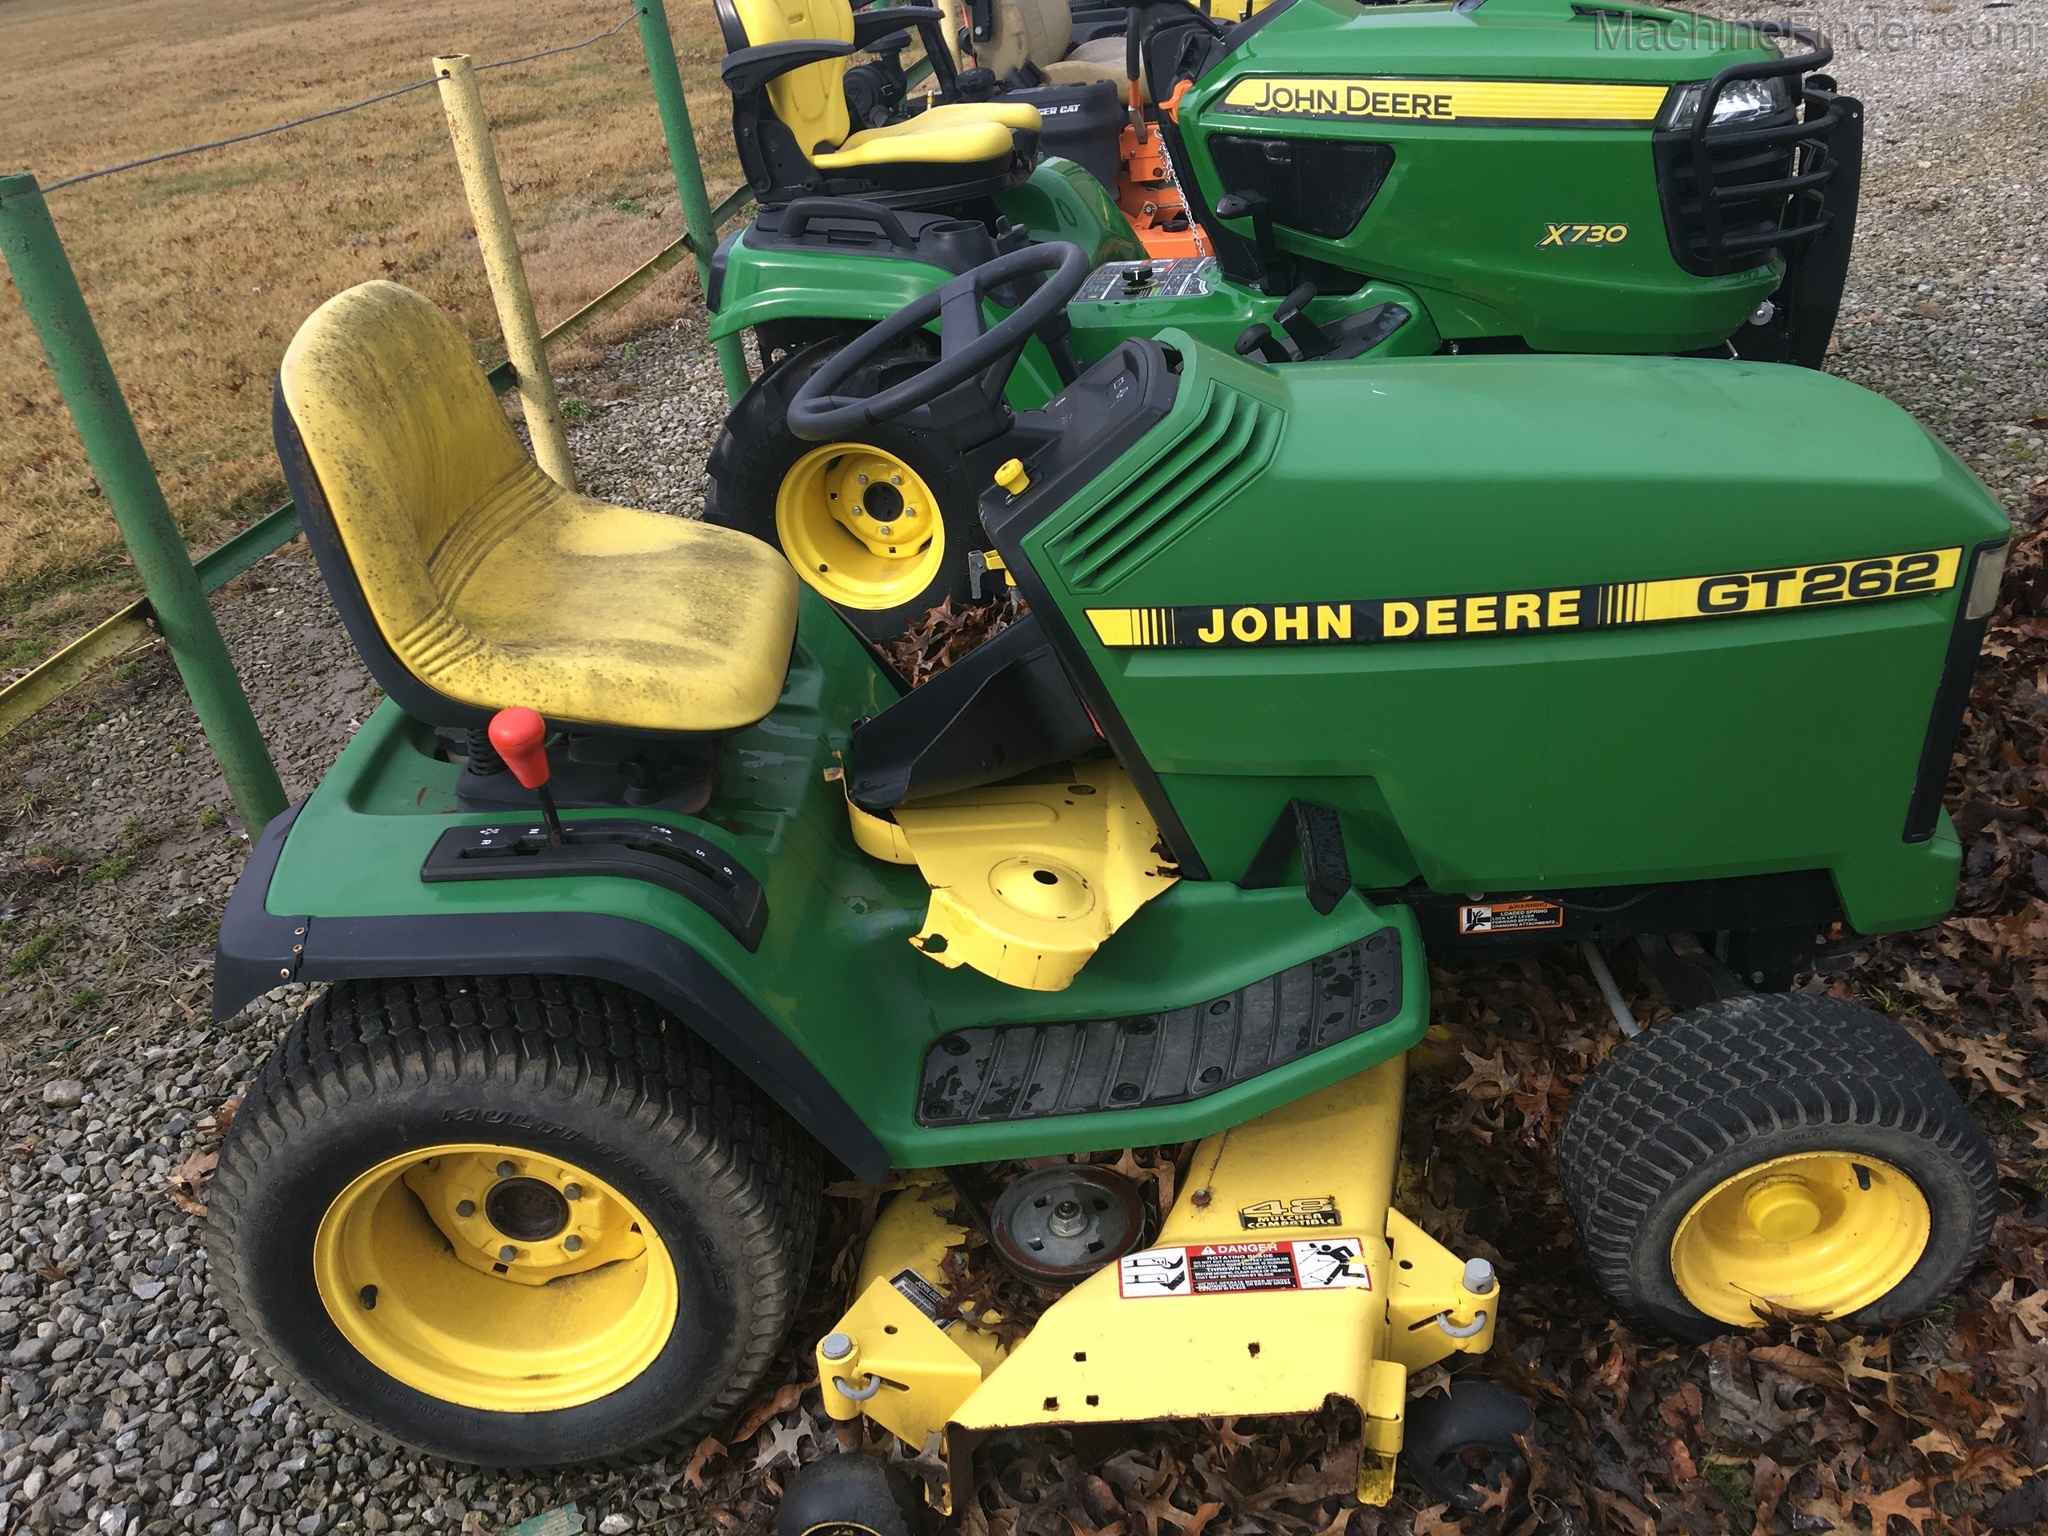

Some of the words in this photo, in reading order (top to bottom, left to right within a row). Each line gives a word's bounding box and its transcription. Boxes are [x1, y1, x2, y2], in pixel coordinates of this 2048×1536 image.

[1060, 104, 1081, 114] CAT
[1255, 82, 1337, 111] JOHN
[1346, 86, 1453, 117] DEERE
[1539, 225, 1629, 246] X730
[1197, 603, 1352, 643] JOHN
[1382, 589, 1581, 637] DEERE
[1696, 553, 1941, 614] GT262
[1744, 1138, 1777, 1154] RATING
[1783, 1130, 1830, 1142] TUBELESS
[1241, 1197, 1334, 1216] 48
[1247, 1218, 1336, 1228] COMPATIBLE
[1217, 1243, 1278, 1254] DANGER
[915, 1280, 932, 1295] JOHN
